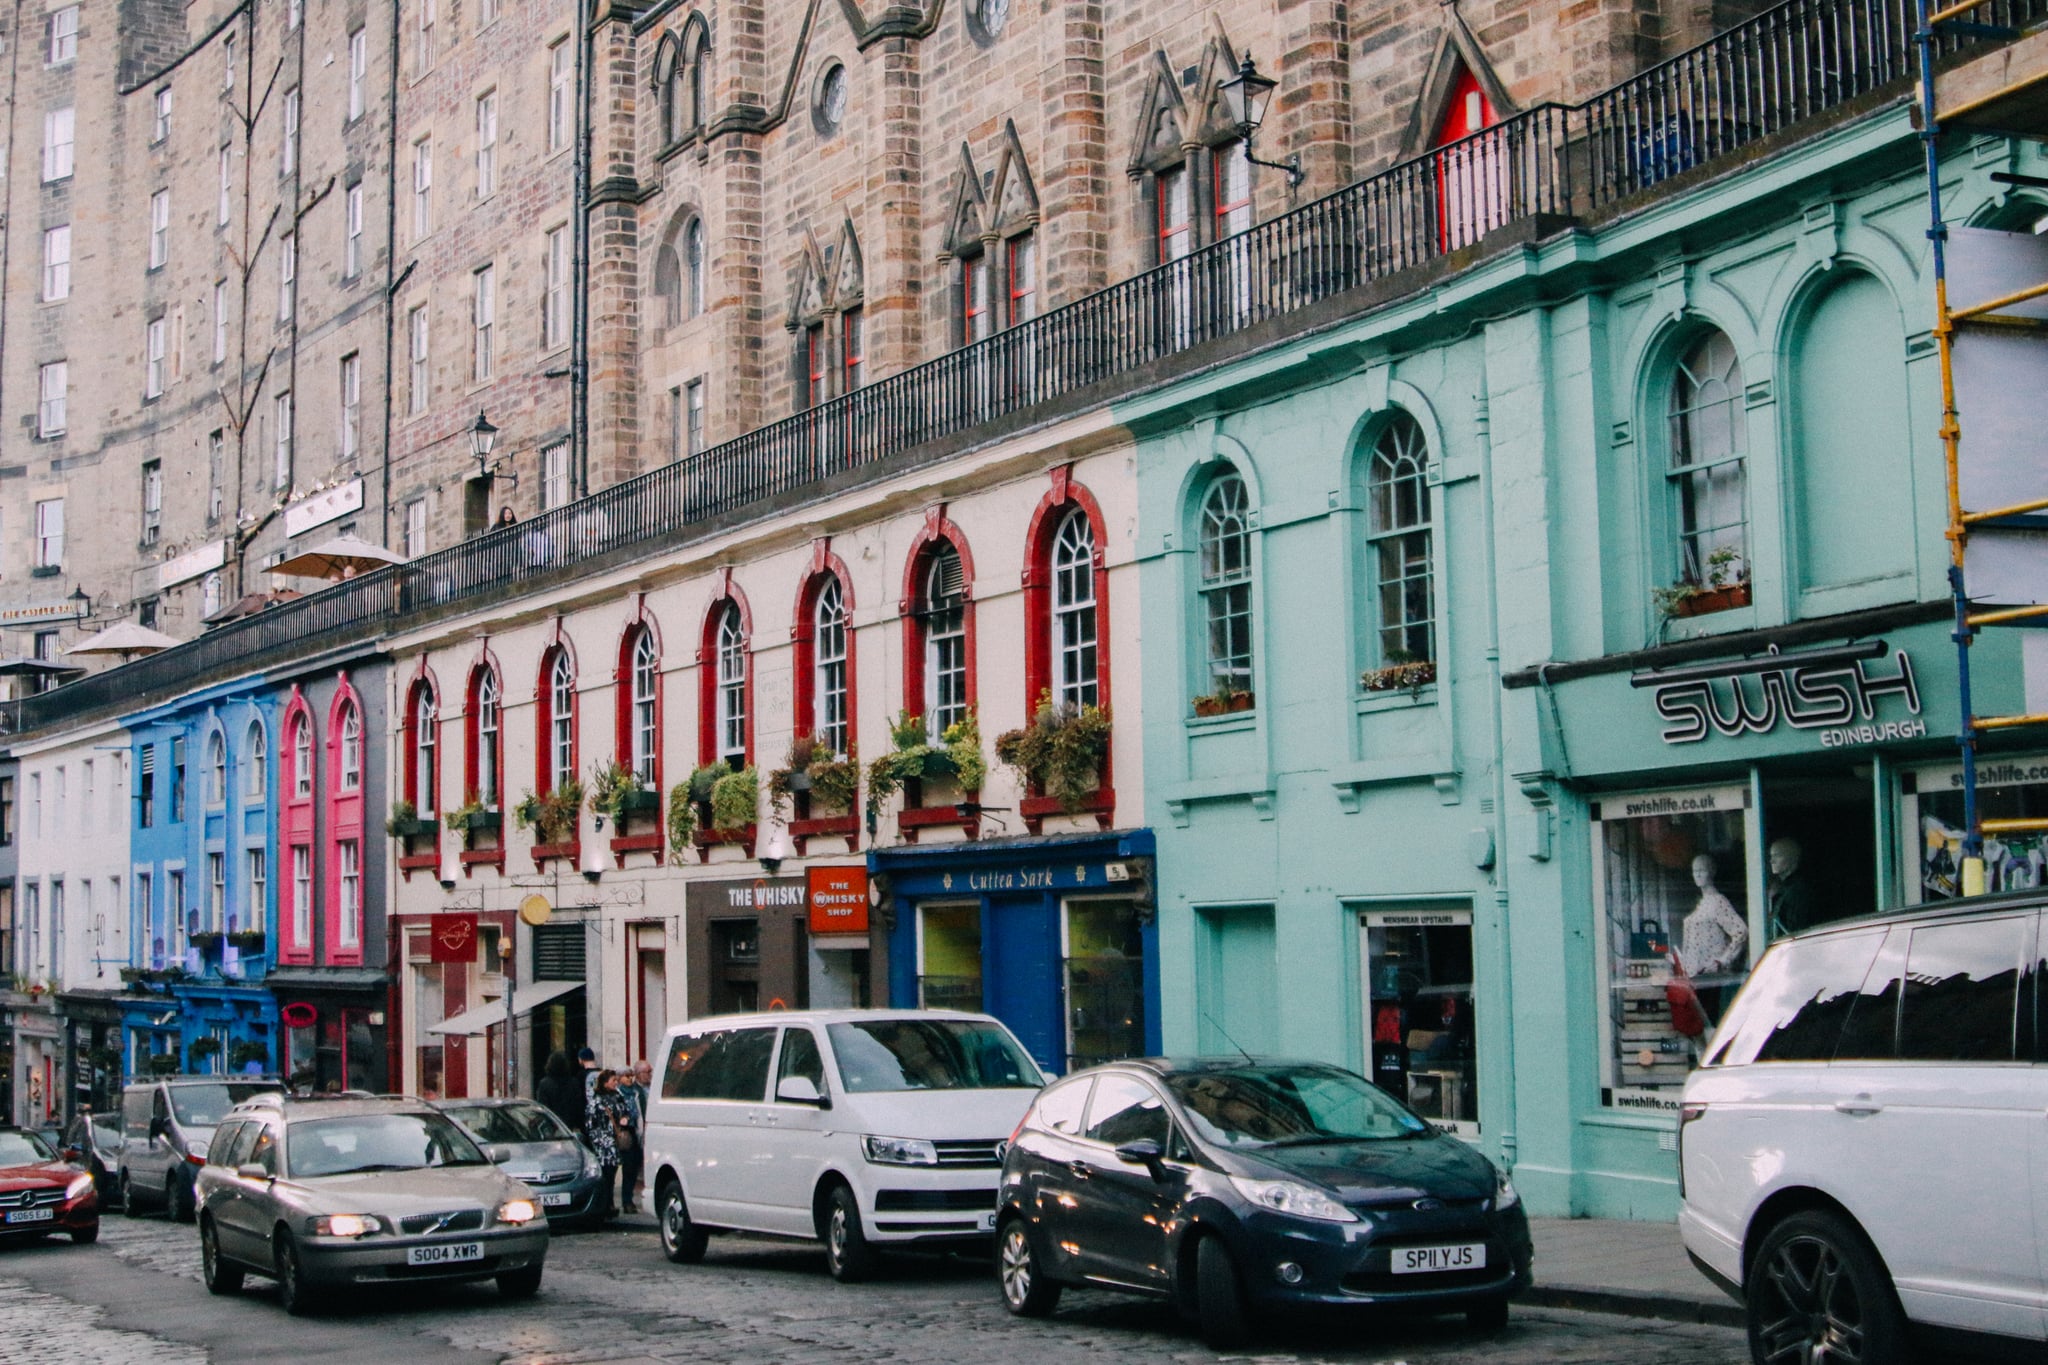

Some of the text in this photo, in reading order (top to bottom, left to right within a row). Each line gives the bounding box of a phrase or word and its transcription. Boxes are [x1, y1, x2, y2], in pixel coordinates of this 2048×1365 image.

[1820, 719, 1926, 748] EDINBURGH
[1626, 795, 1715, 815] swishlife.co.uk
[829, 882, 849, 890] THE
[1020, 866, 1053, 888] Sark
[728, 886, 806, 906] THE WHISKY
[815, 894, 865, 904] WHISKY
[827, 908, 853, 916] SHOP
[453, 1244, 478, 1258] XWR
[1442, 1247, 1472, 1266] YJS
